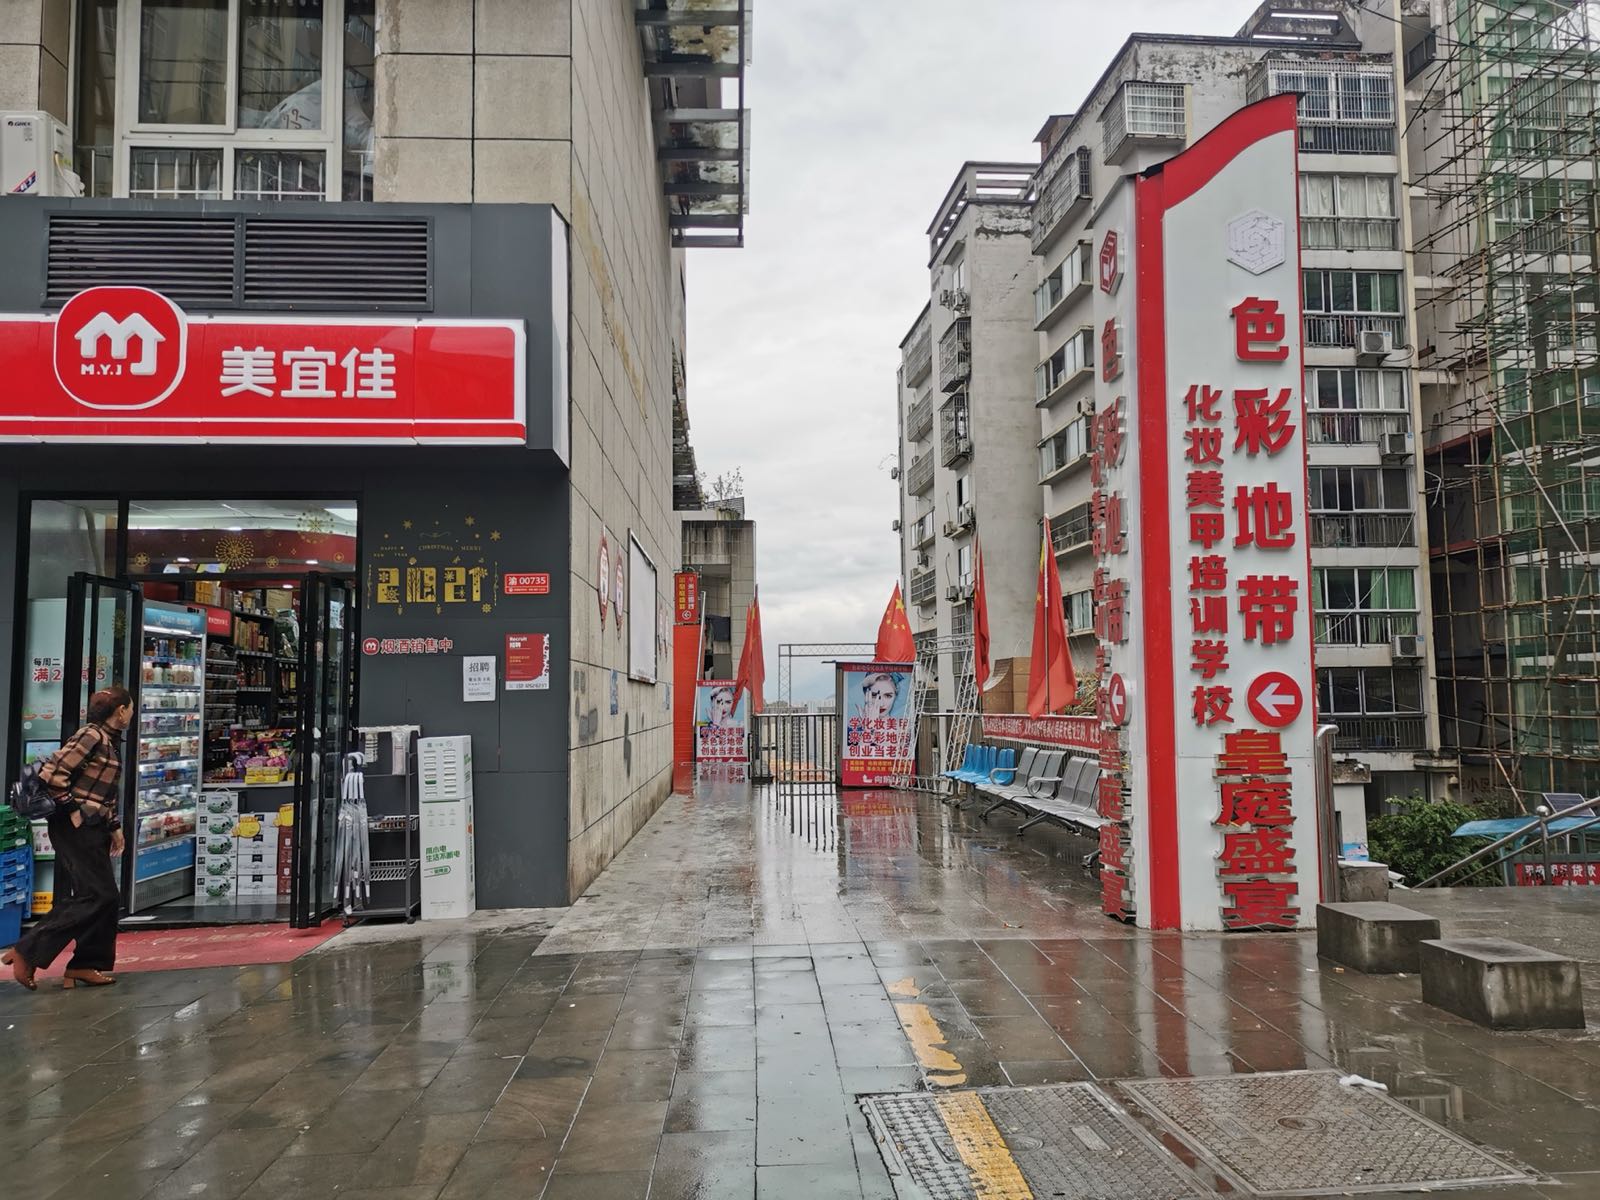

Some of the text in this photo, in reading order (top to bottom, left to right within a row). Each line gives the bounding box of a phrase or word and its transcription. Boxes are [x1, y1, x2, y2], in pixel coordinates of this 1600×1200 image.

[80, 363, 123, 376] M.Y.J
[219, 346, 397, 399] 美宜佳
[1230, 295, 1299, 646] 色彩地带
[519, 576, 546, 585] 00735
[1183, 384, 1232, 726] 化妆美甲培训学校
[380, 636, 454, 655] 烟酒销售中
[1214, 729, 1298, 930] 皇庭盛宴
